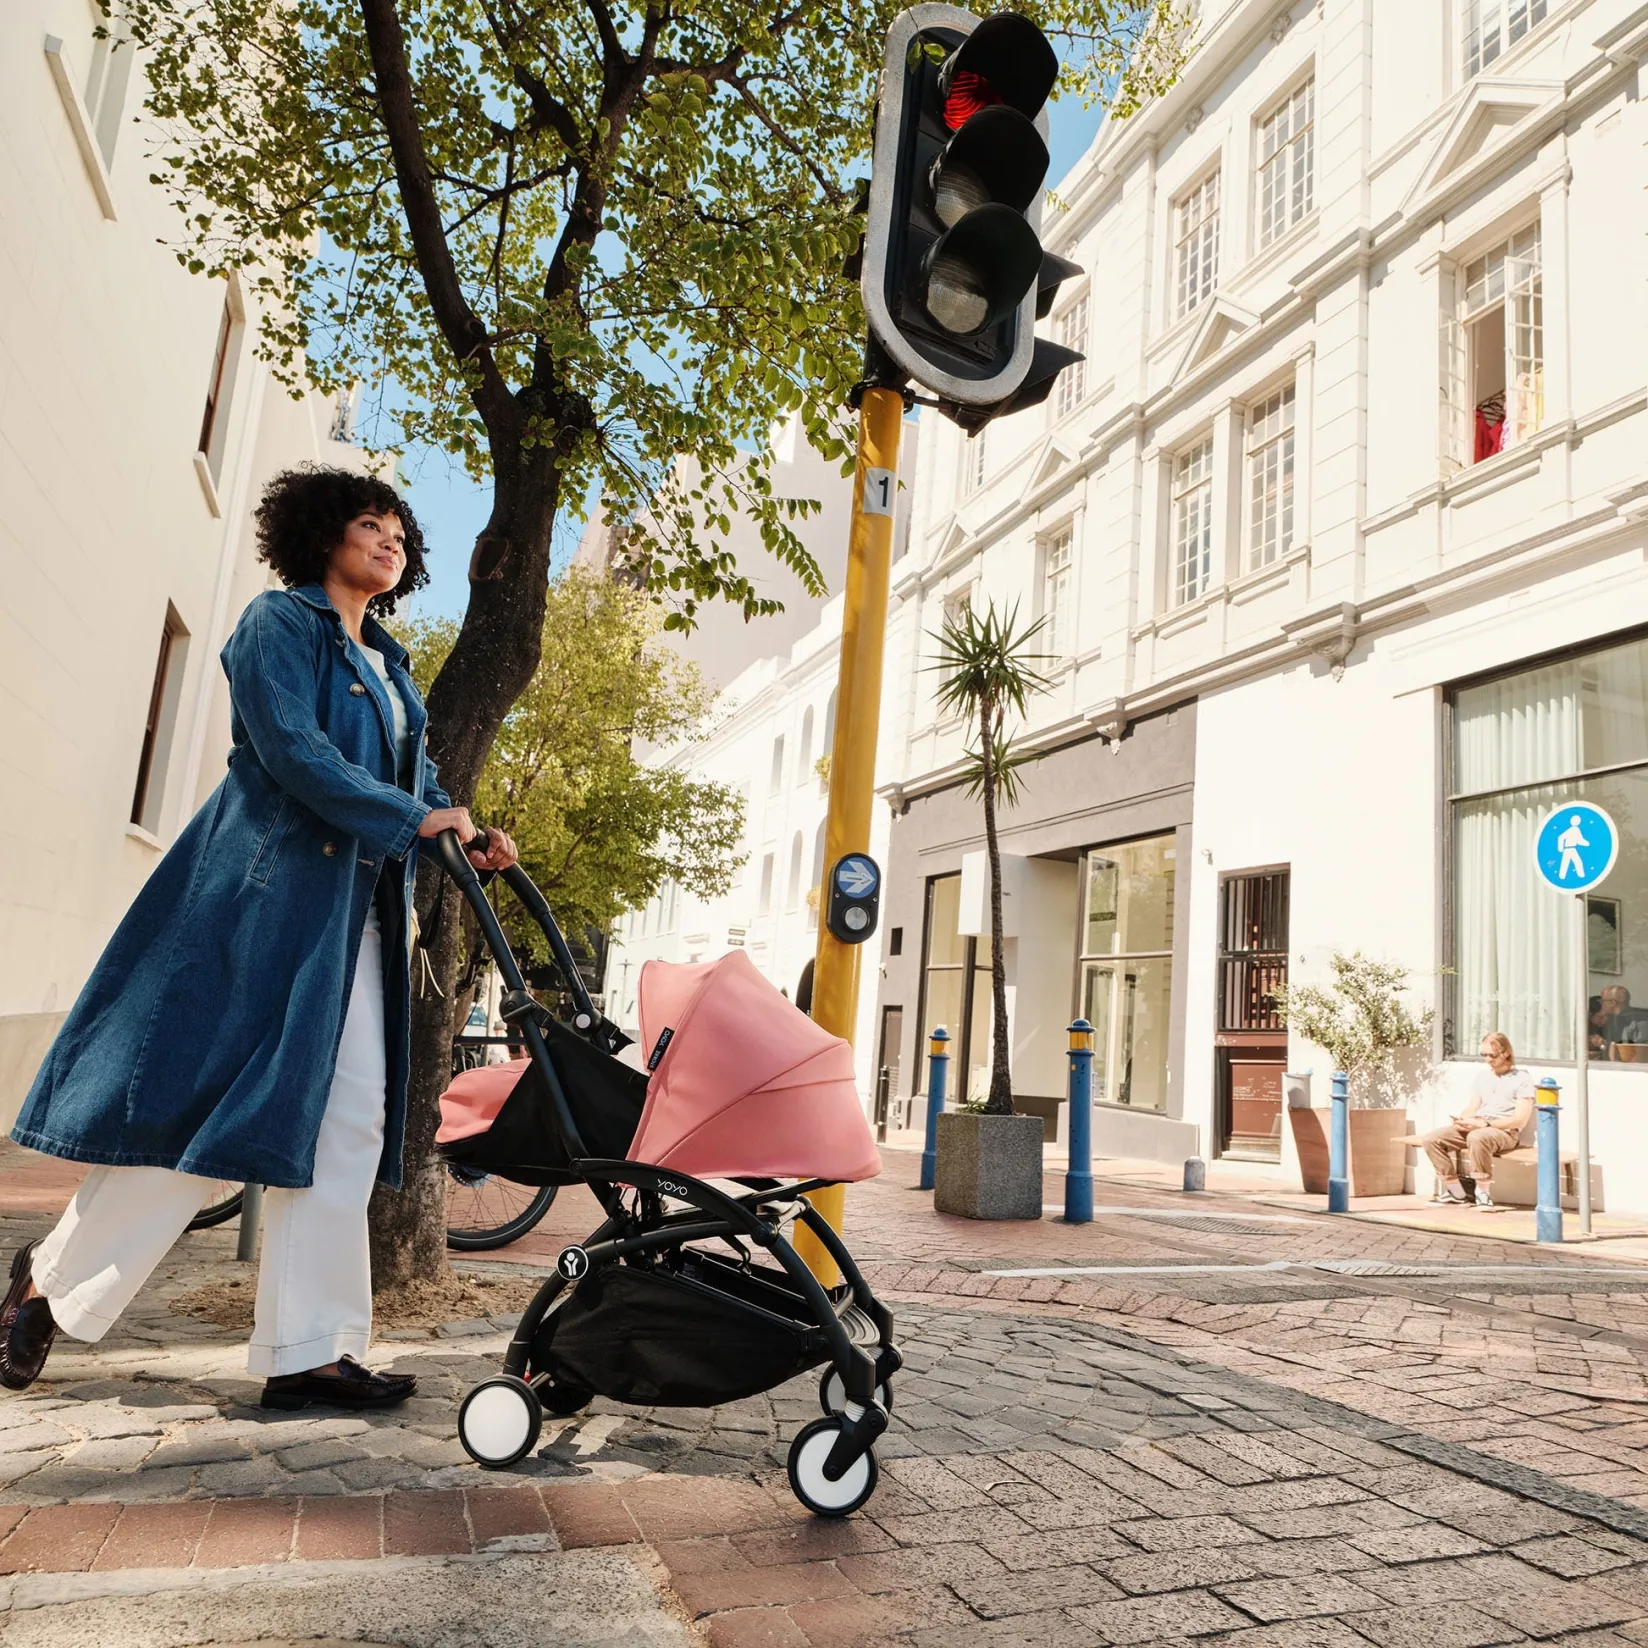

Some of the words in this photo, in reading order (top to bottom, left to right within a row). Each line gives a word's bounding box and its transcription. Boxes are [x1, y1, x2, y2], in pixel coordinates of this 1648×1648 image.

[878, 476, 889, 508] 1
[659, 1030, 671, 1046] YOYO
[657, 1178, 688, 1196] YOYO
